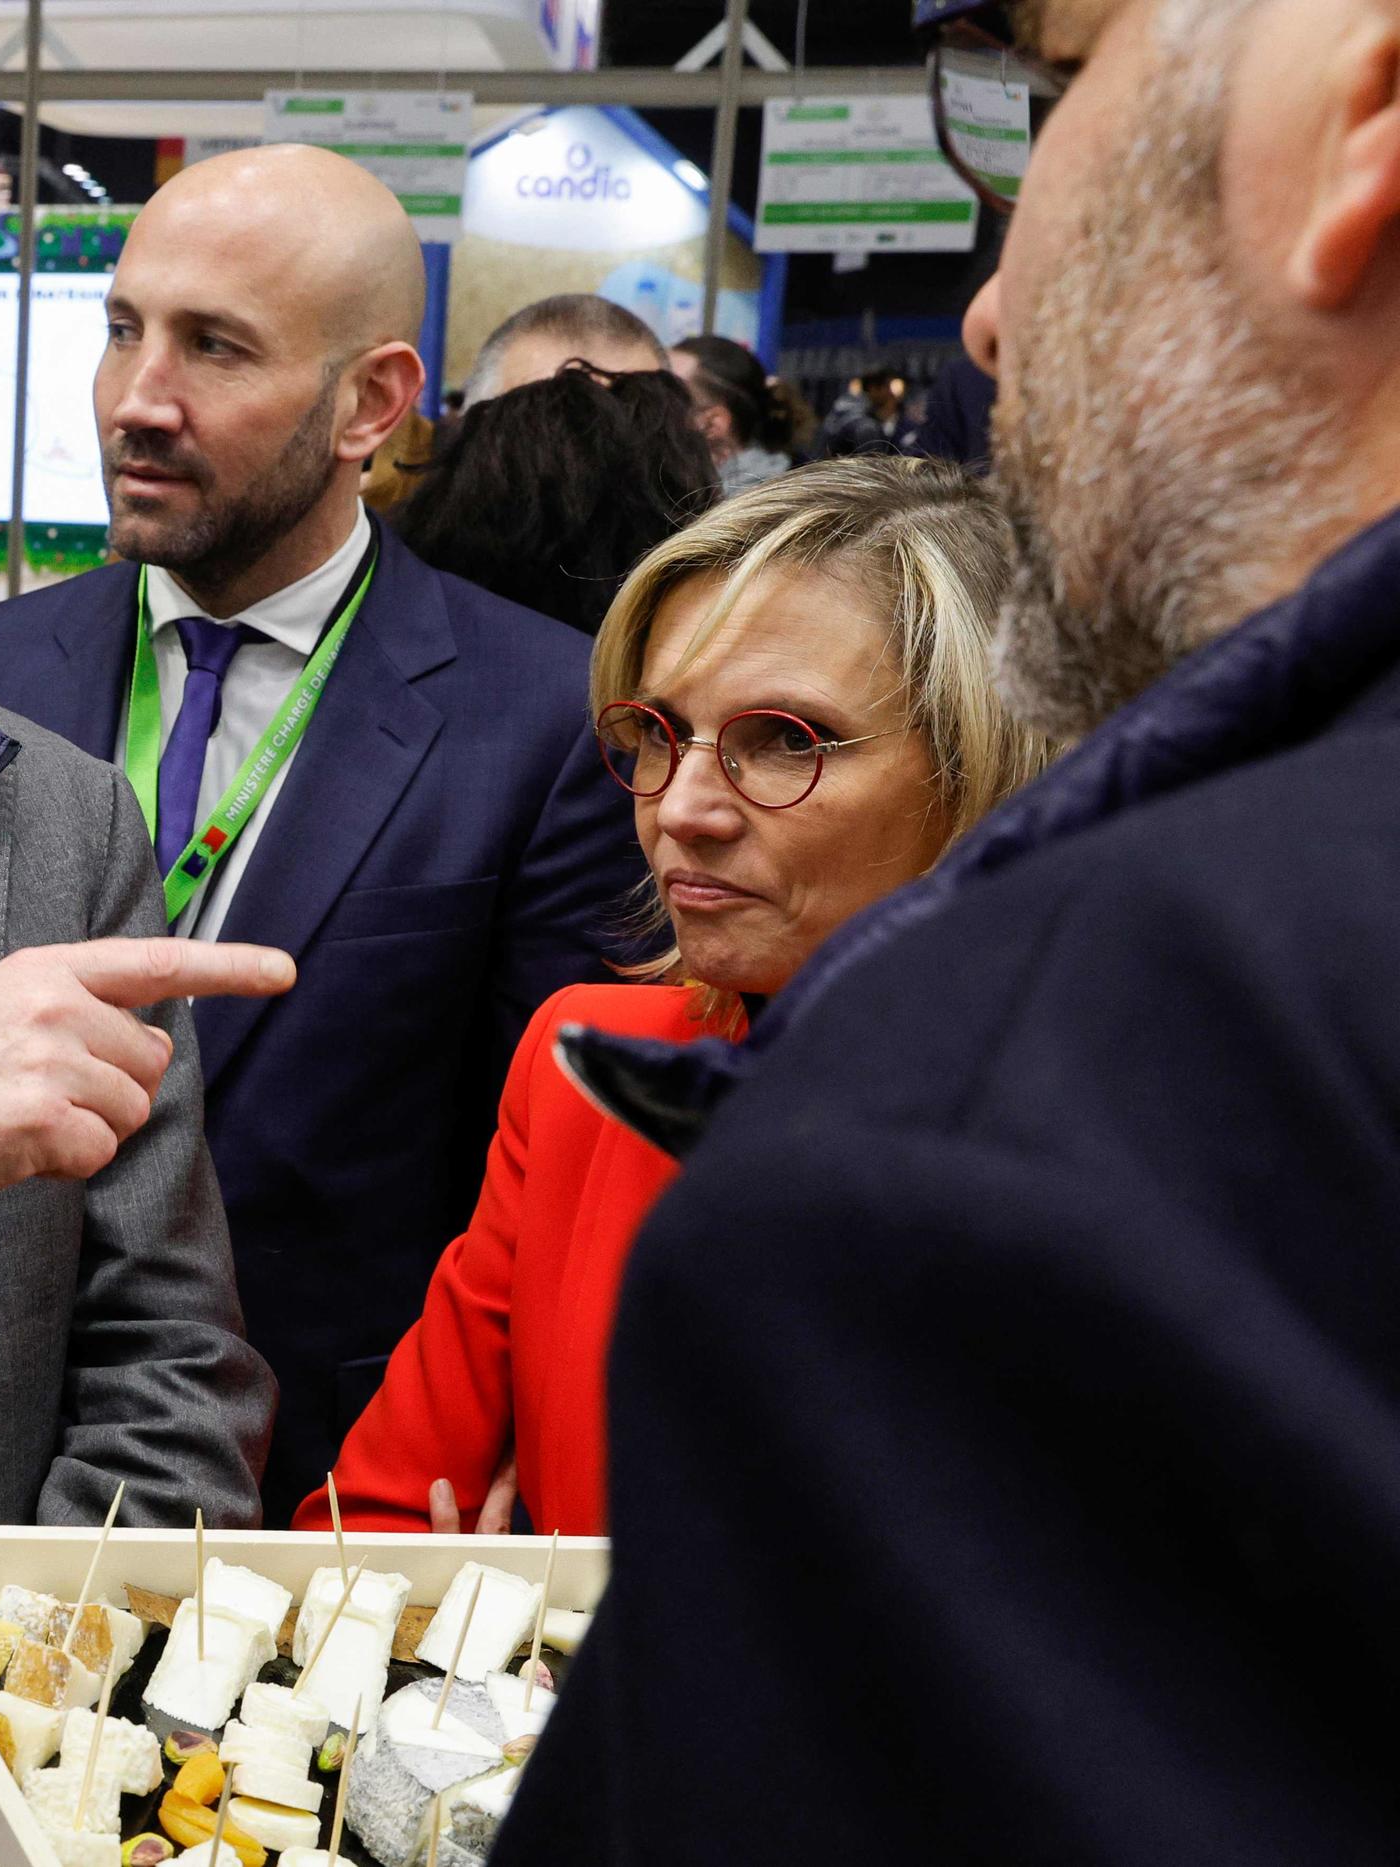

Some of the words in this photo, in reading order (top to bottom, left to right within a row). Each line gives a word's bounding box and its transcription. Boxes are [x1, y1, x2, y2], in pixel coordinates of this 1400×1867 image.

[516, 166, 632, 201] candia
[224, 748, 277, 823] MINISTÈRE
[271, 688, 314, 749] CHARGÉ
[310, 667, 328, 690] DE
